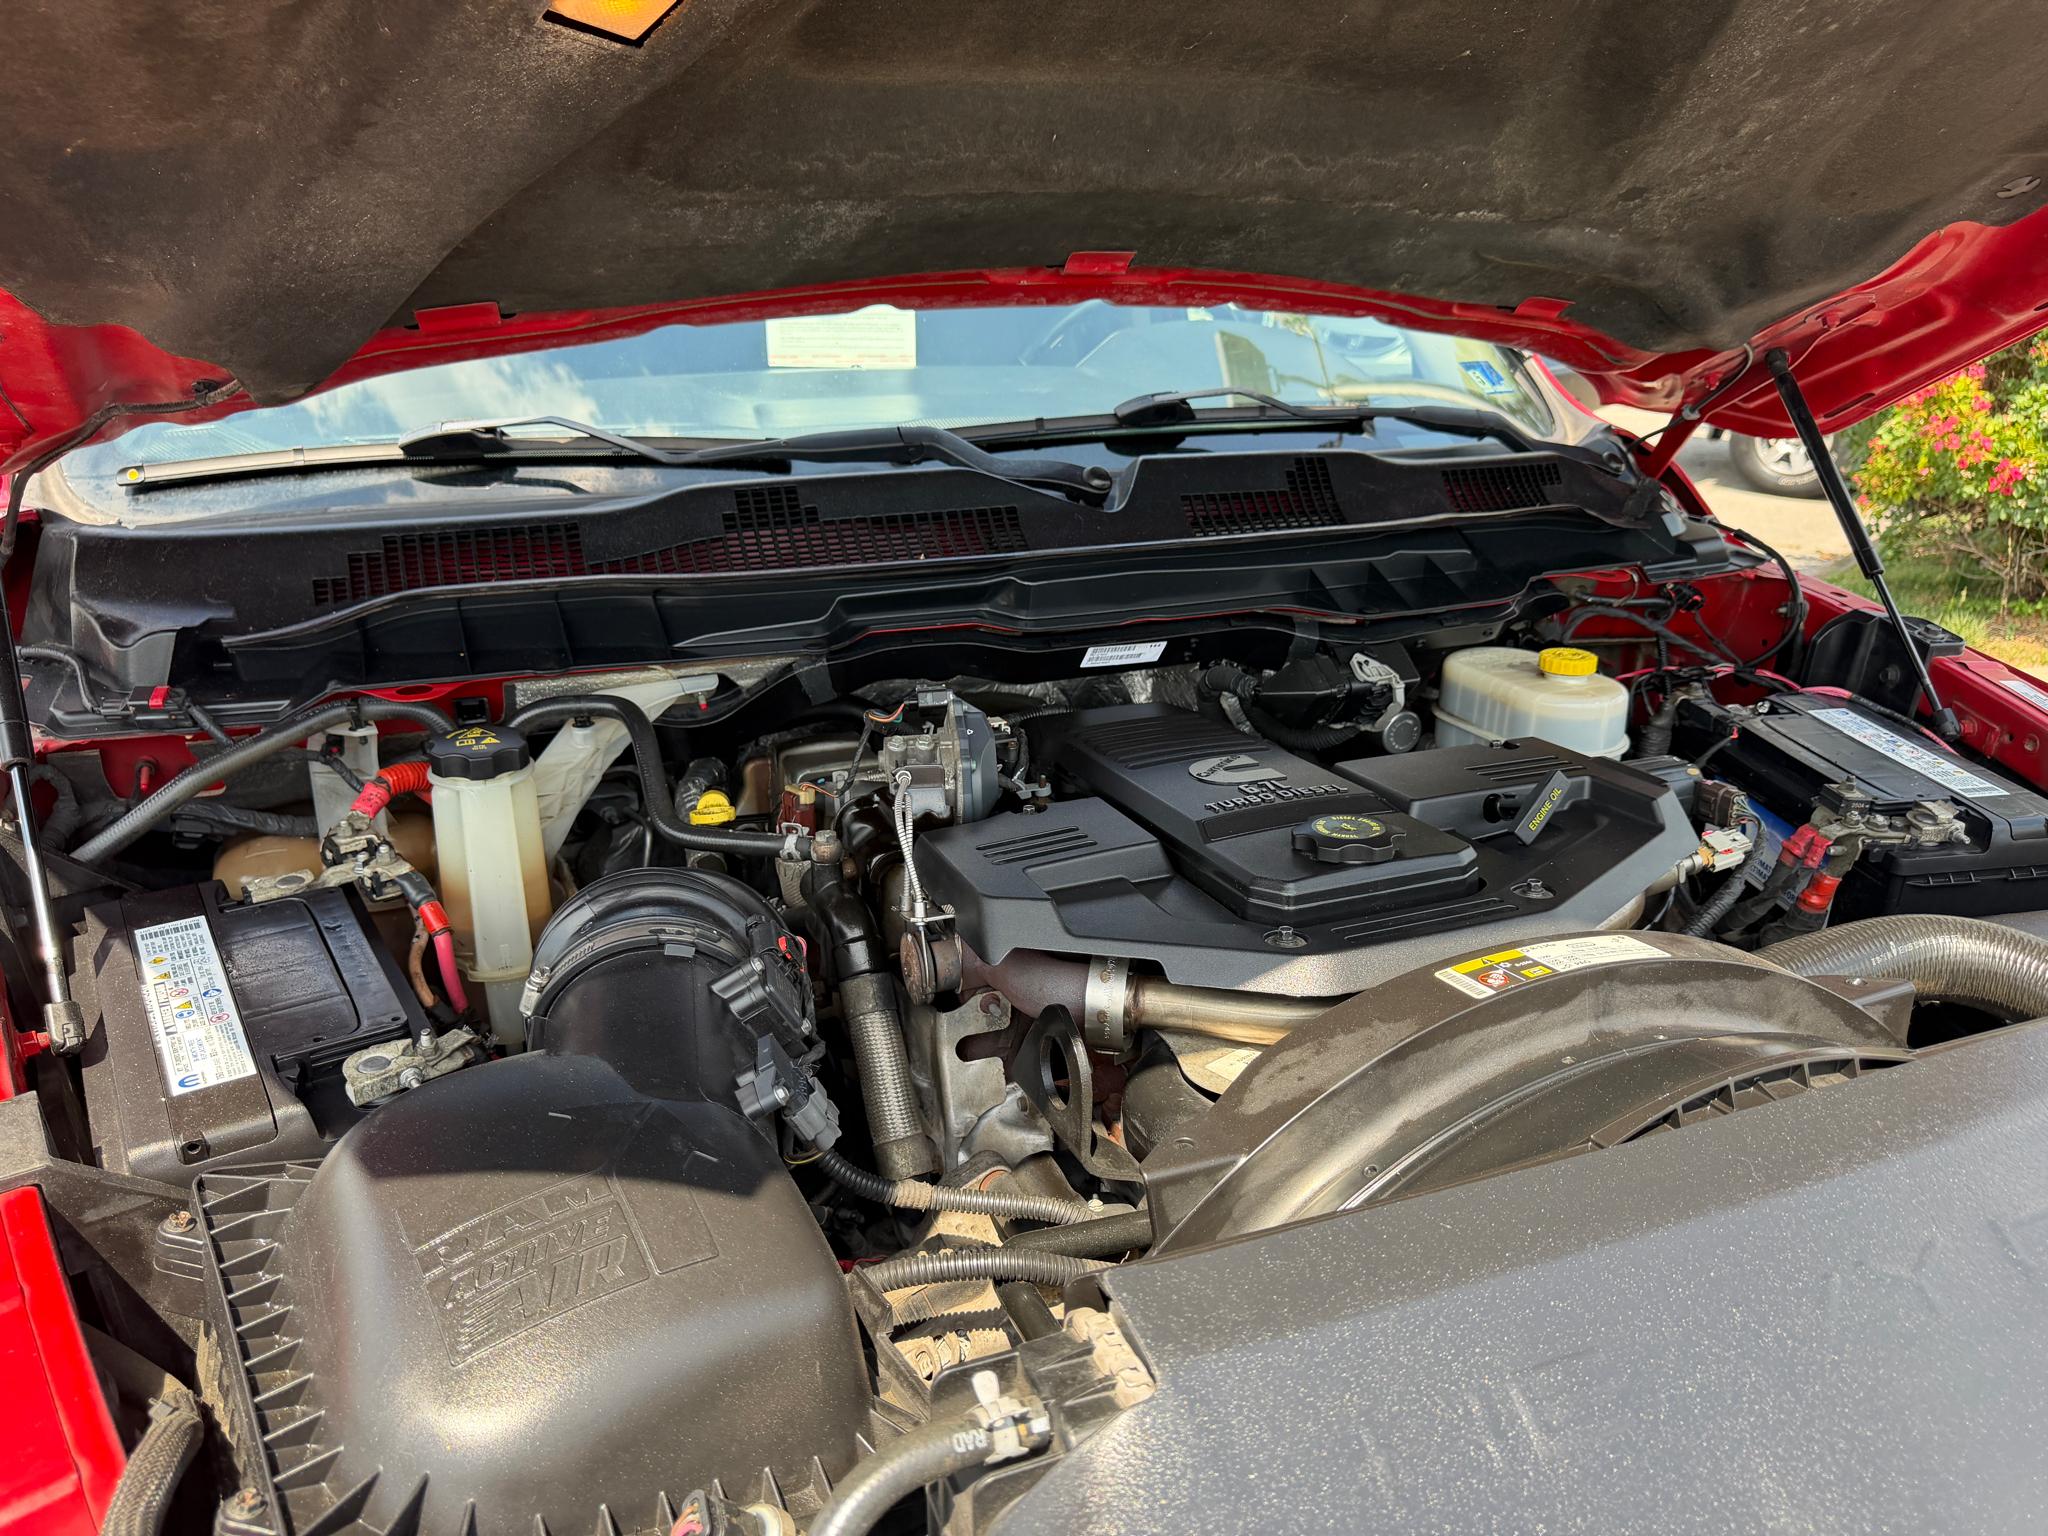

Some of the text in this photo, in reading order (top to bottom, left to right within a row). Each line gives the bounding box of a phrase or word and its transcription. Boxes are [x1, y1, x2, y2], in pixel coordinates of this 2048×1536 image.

[1204, 784, 1348, 813] TURBO DIESEL
[1238, 779, 1293, 795] 6.7L
[1528, 788, 1562, 831] ENGINE OIL
[424, 1180, 613, 1278] RAM
[444, 1207, 613, 1308] ACTIVE
[464, 1233, 630, 1342] AIR
[953, 1428, 988, 1453] RAD
